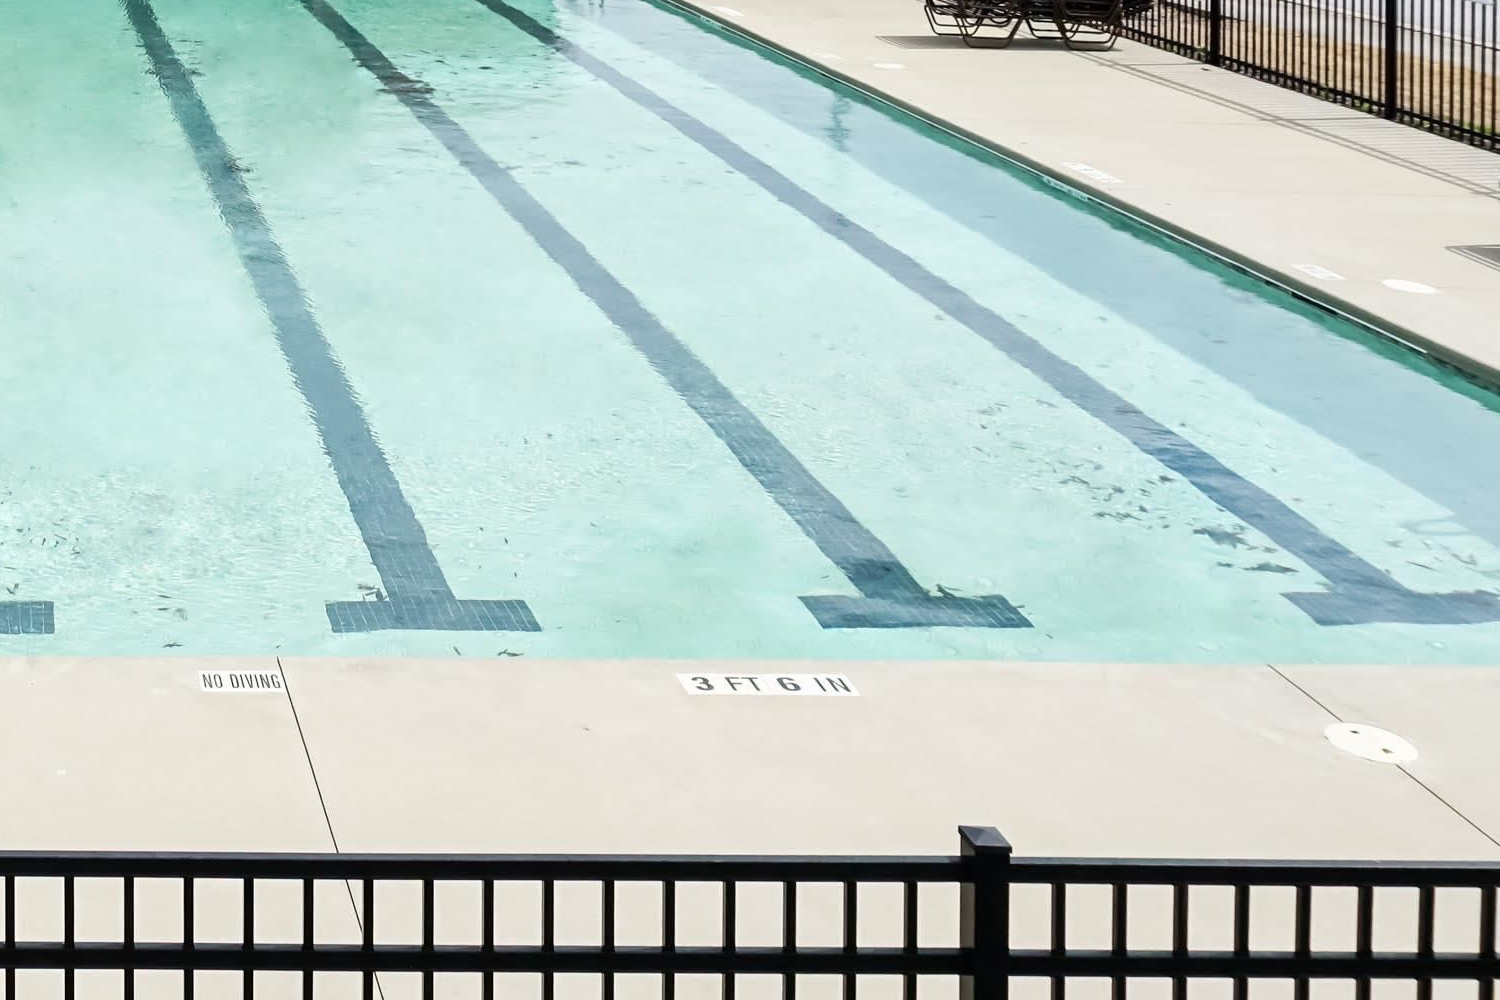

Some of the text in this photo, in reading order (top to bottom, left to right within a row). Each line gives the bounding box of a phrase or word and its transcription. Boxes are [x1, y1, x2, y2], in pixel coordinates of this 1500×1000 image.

[201, 673, 281, 689] NO DIVING
[690, 676, 853, 693] 3 FT 6 IN
